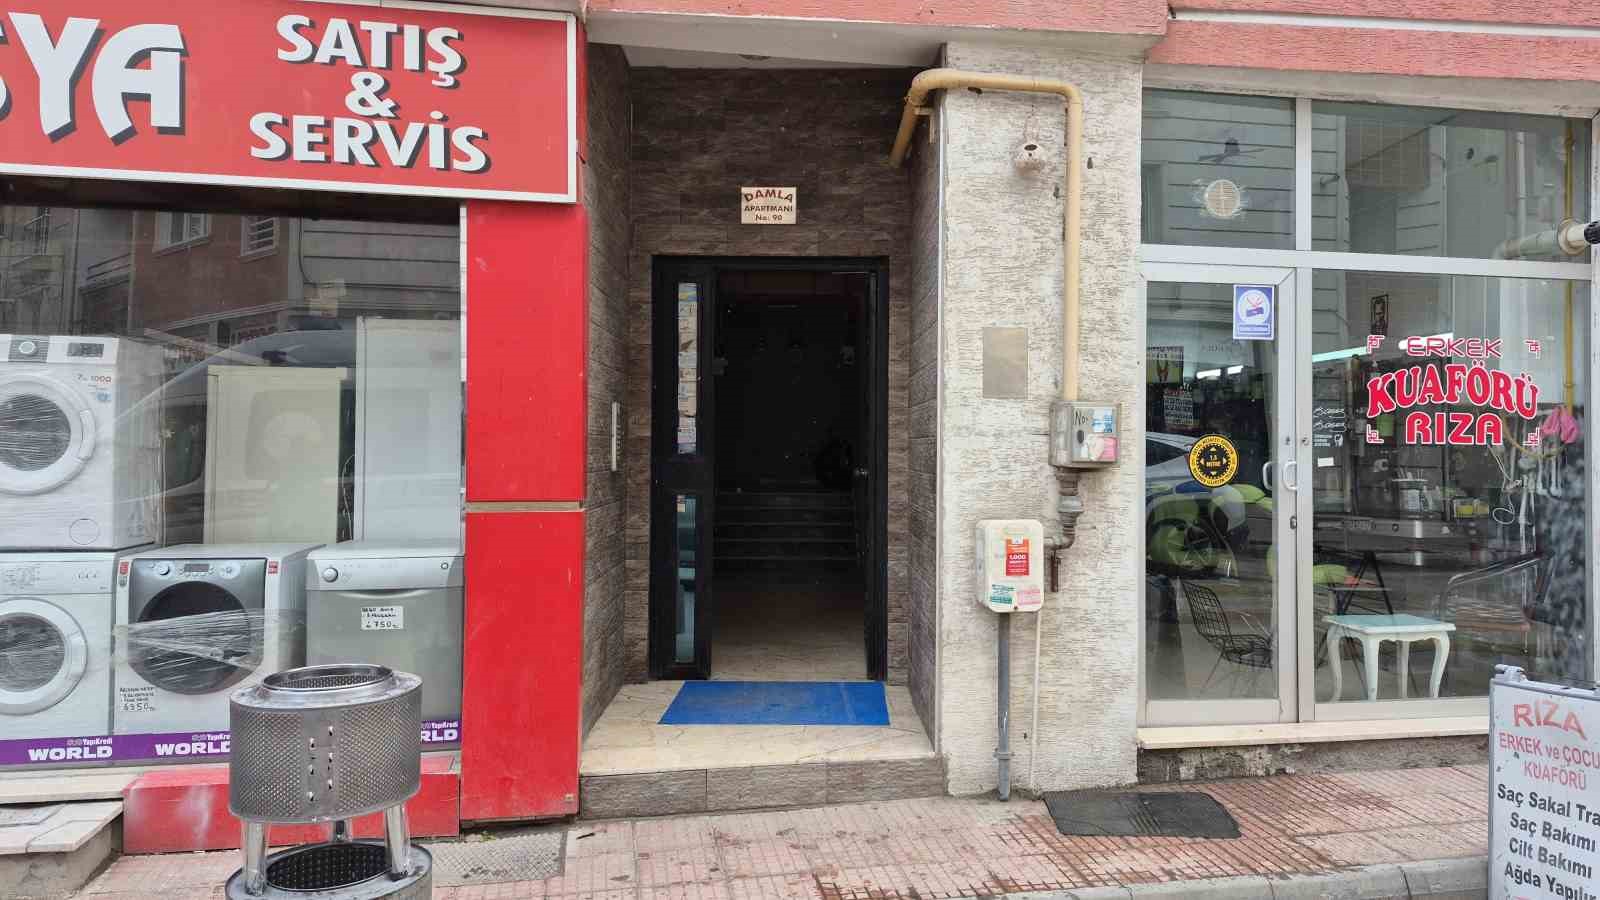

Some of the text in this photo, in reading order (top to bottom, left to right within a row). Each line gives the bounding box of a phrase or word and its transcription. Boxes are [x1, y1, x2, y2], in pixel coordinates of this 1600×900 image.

[276, 14, 465, 87] SATIŞ
[0, 11, 187, 142] YA
[344, 71, 399, 118] &
[249, 110, 489, 173] SERVİS
[744, 188, 793, 203] DAMLA
[1406, 335, 1503, 358] ERKEK
[1366, 359, 1540, 420] KUAFÖRÜ
[1405, 411, 1503, 445] RIZA
[420, 729, 458, 742] RLD
[1513, 699, 1588, 741] RIZA
[28, 745, 113, 761] WORLD
[1498, 732, 1543, 757] ERKEK
[1545, 744, 1560, 760] ve
[1497, 783, 1525, 808] Saç
[1528, 791, 1571, 818] Sakal
[1509, 811, 1596, 853] Saç Bakımı
[1504, 861, 1542, 889] Ağda
[1509, 837, 1592, 879] Cilt Bakımı
